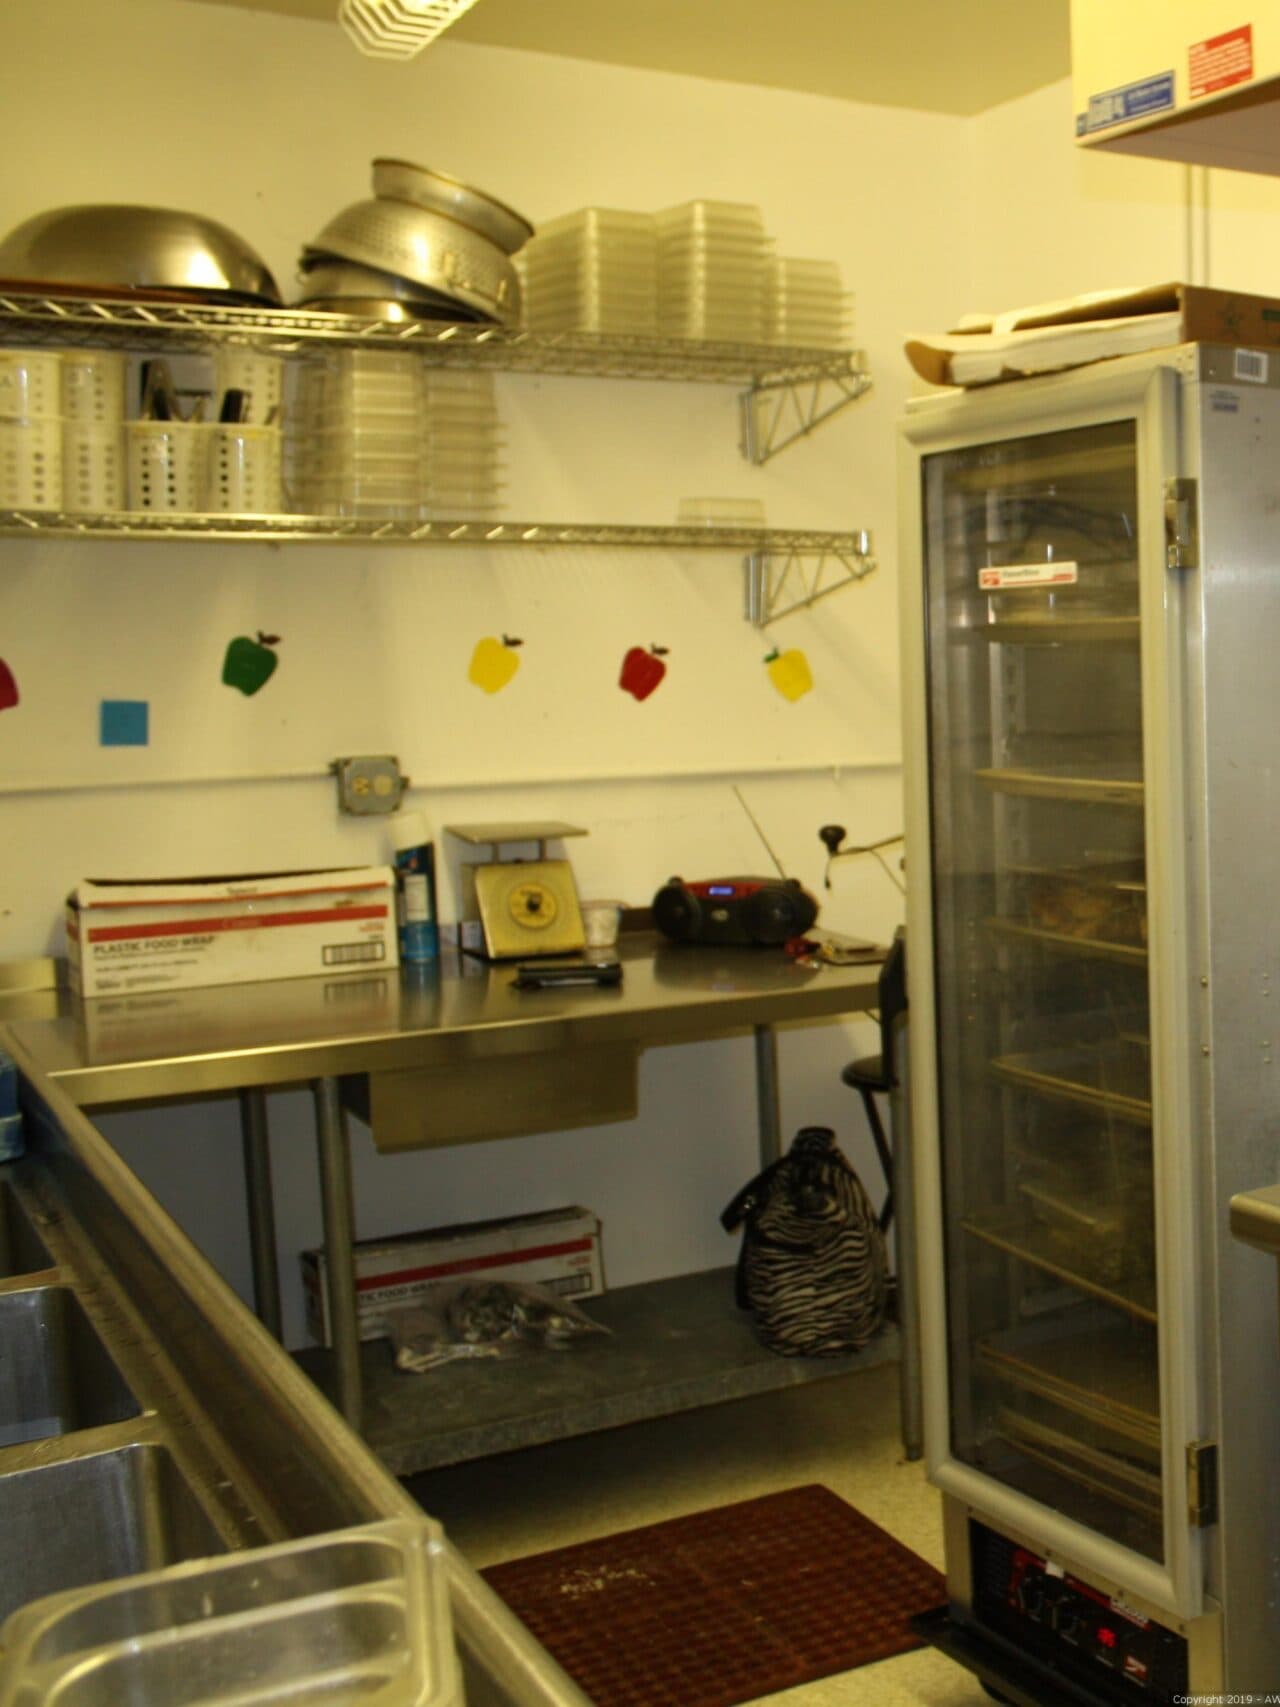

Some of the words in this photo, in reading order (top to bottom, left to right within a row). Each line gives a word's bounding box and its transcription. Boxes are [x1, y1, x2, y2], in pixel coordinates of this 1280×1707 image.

[93, 941, 140, 954] PLASTIC
[144, 938, 178, 949] FOOD
[181, 935, 217, 946] WRAP
